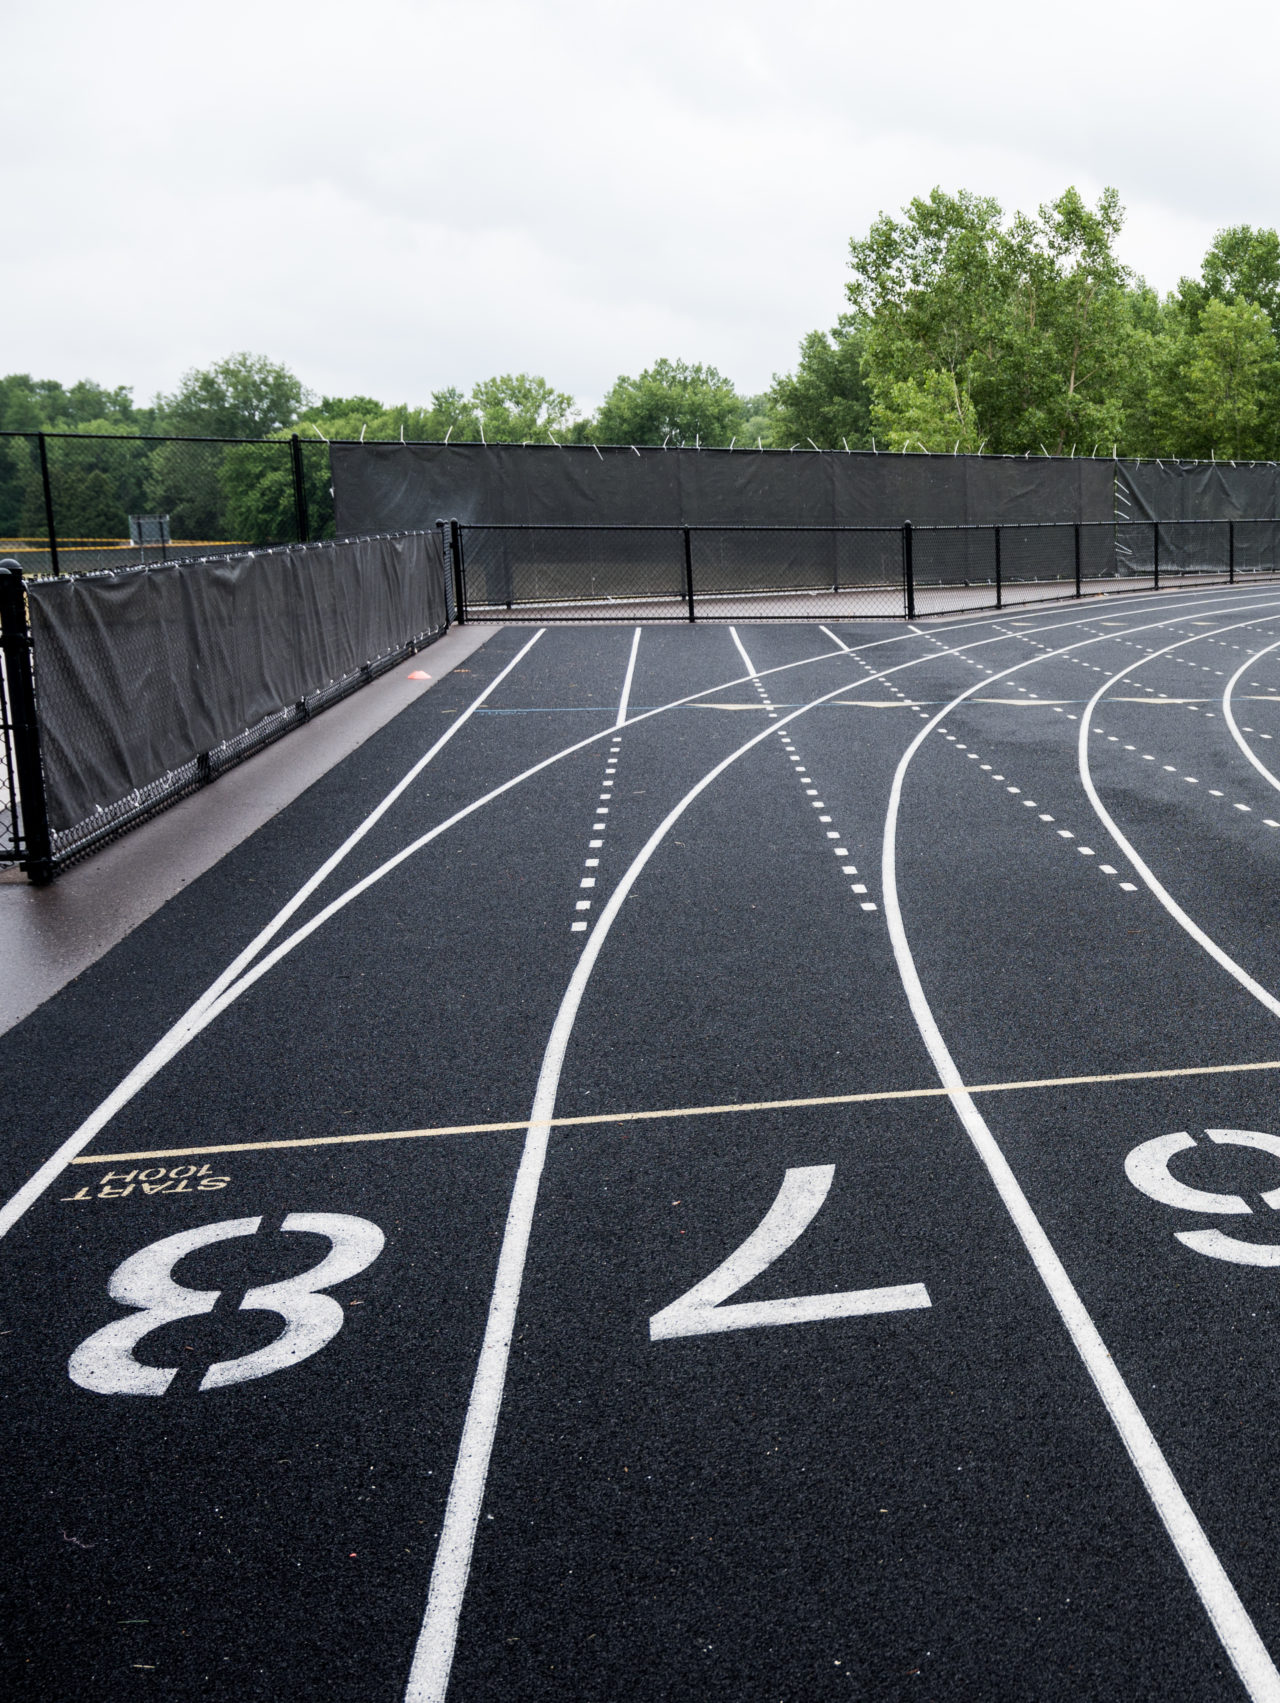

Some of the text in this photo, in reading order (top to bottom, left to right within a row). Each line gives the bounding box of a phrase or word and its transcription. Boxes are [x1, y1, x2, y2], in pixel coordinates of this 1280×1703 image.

[60, 1176, 231, 1202] START
[99, 1164, 213, 1185] 100H
[649, 1164, 932, 1341] 7
[68, 1212, 386, 1396] 8
